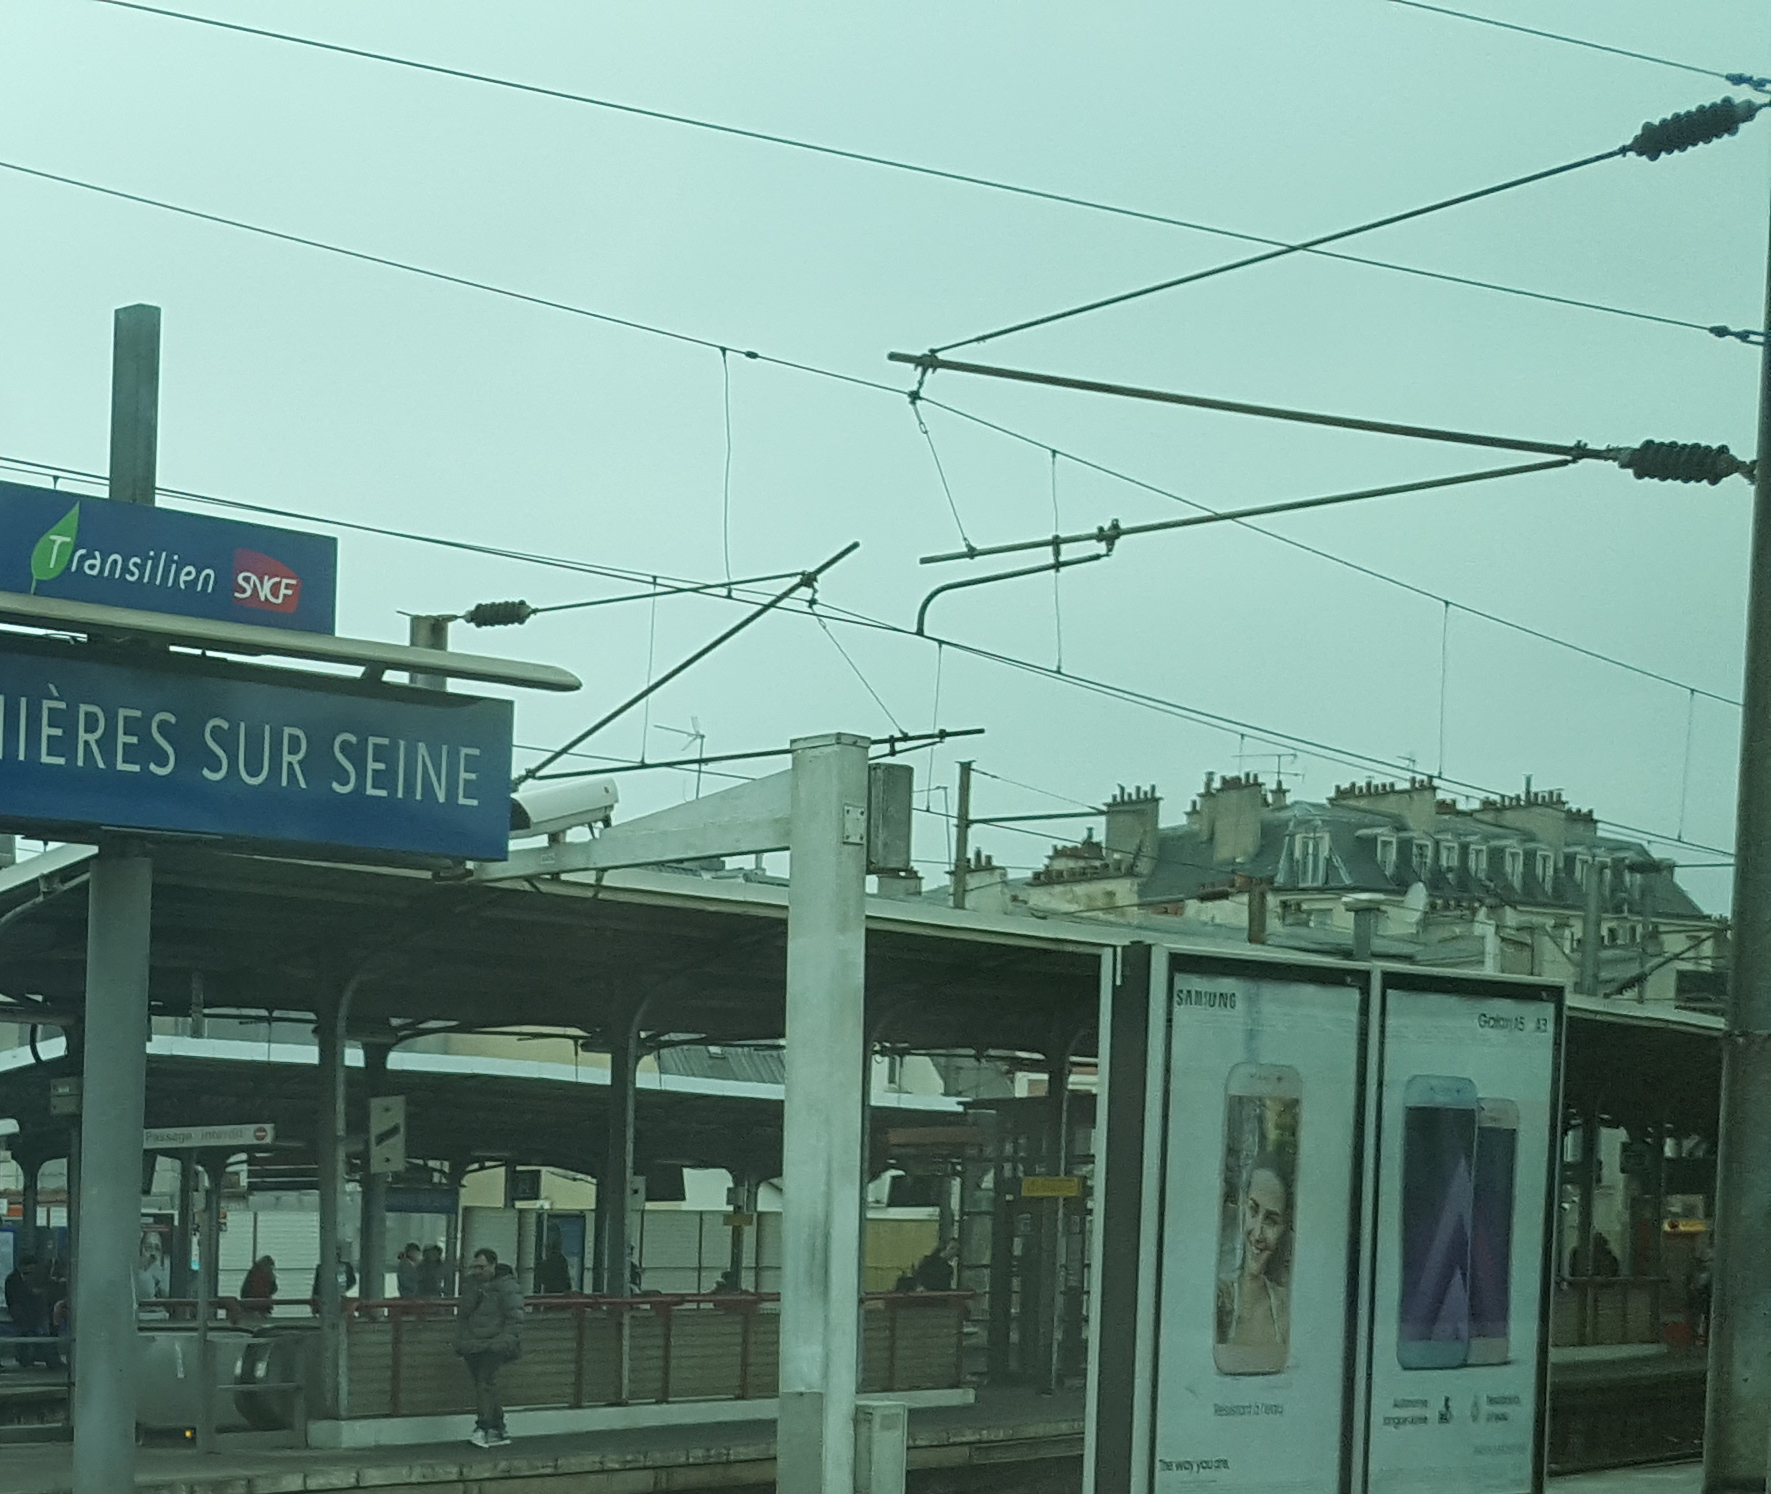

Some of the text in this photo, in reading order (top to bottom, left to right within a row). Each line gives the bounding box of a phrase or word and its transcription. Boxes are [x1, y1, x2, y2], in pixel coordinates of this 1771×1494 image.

[43, 534, 298, 604] Transilien SNCF
[201, 716, 308, 790] SUR
[330, 731, 481, 807] SEINE
[1175, 989, 1237, 1009] SAMSUNG
